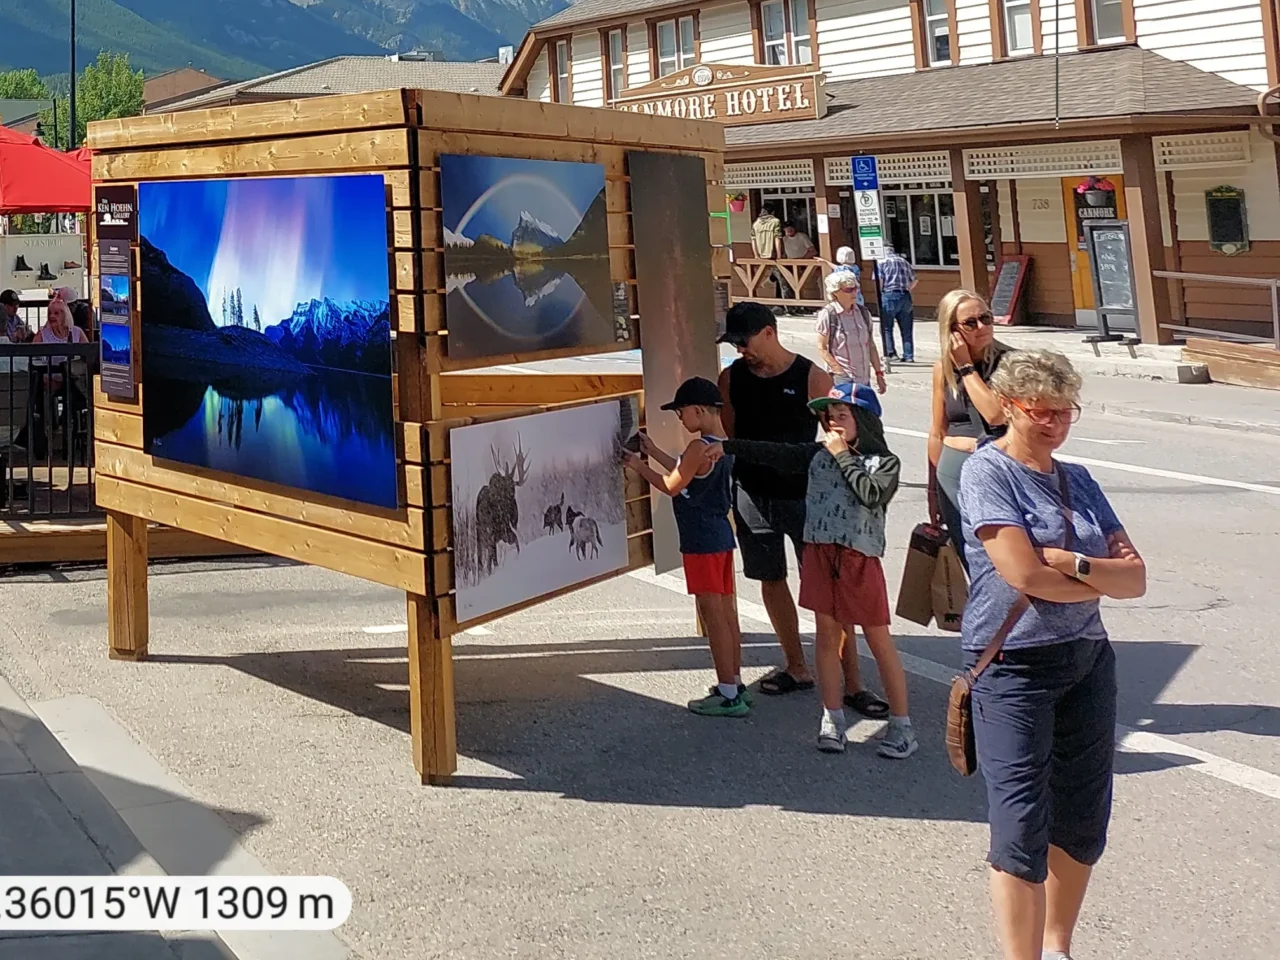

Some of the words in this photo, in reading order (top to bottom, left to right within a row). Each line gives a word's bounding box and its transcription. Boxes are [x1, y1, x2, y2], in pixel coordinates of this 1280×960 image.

[620, 94, 716, 119] NMORE
[726, 82, 810, 117] HOTEL
[97, 202, 110, 212] KEN
[110, 202, 133, 212] HOEHN
[1031, 198, 1050, 210] 738
[1078, 207, 1115, 218] CANMORE
